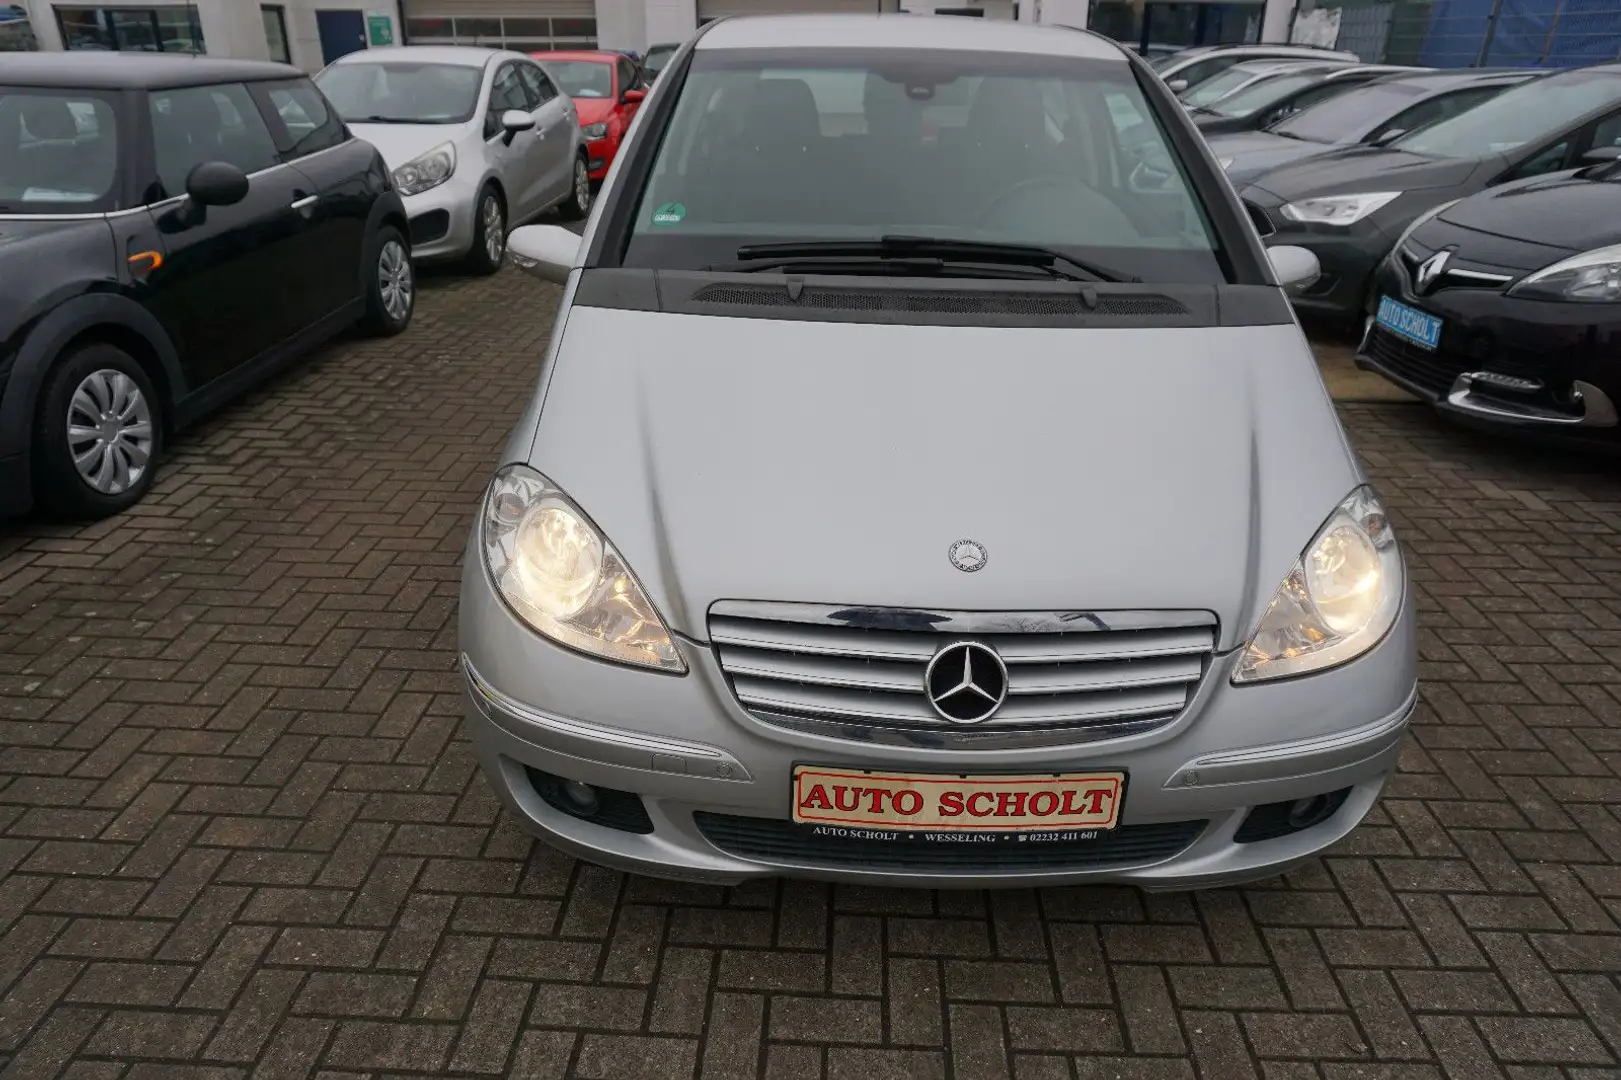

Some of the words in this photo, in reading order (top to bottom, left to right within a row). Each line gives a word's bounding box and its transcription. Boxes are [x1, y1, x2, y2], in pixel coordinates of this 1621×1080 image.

[1379, 299, 1402, 326] AUTO
[1400, 309, 1440, 343] SCHOLT
[801, 784, 924, 815] AUTO
[938, 790, 1112, 817] SCHOLT
[813, 826, 847, 836] AUTO
[850, 829, 899, 840] SCHOLT
[925, 833, 996, 843] WESSELING
[1029, 833, 1059, 842] 02232
[1061, 832, 1078, 841] 411
[1080, 831, 1098, 840] 601
